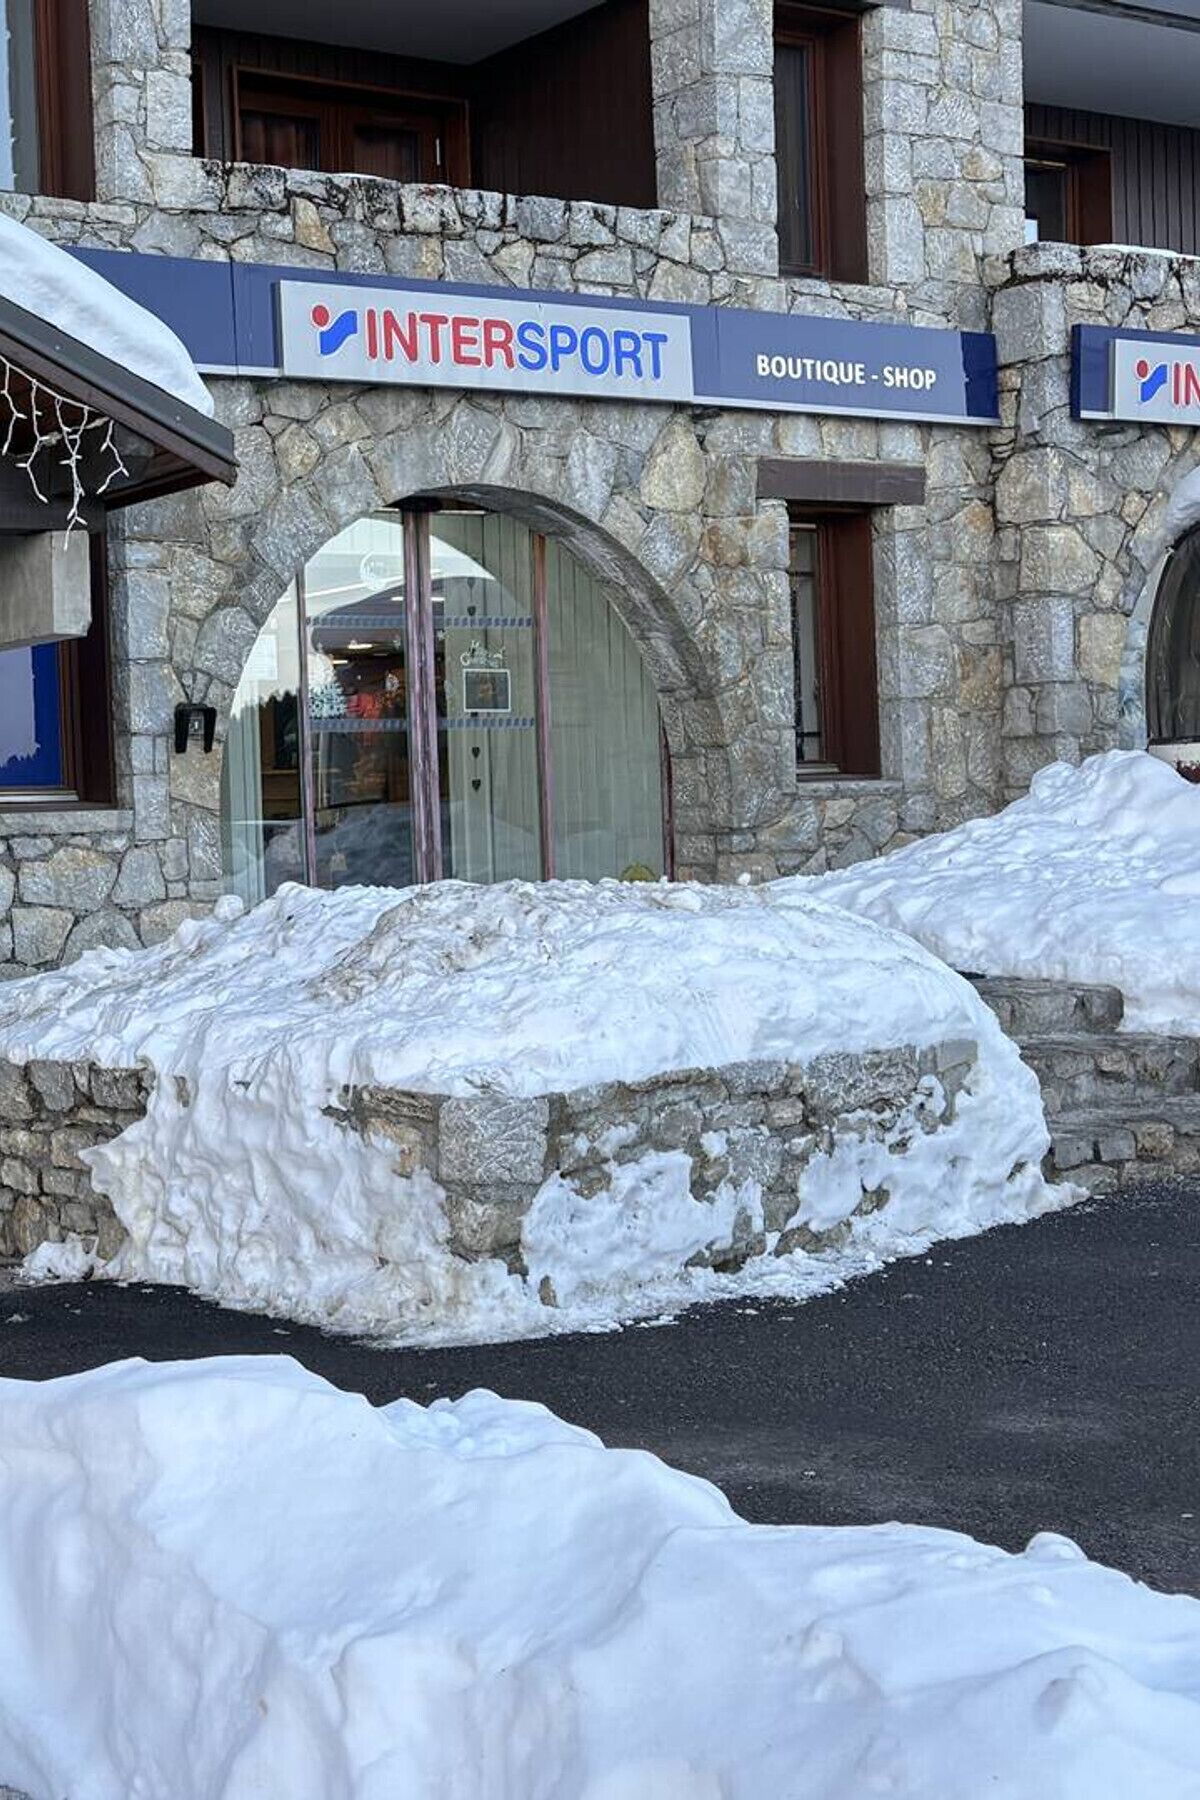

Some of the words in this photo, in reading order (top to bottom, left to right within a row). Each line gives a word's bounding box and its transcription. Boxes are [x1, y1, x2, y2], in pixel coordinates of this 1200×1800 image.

[366, 308, 668, 379] INTERSPORT
[756, 354, 866, 385] BOUTIQUE
[883, 366, 937, 390] SHOP
